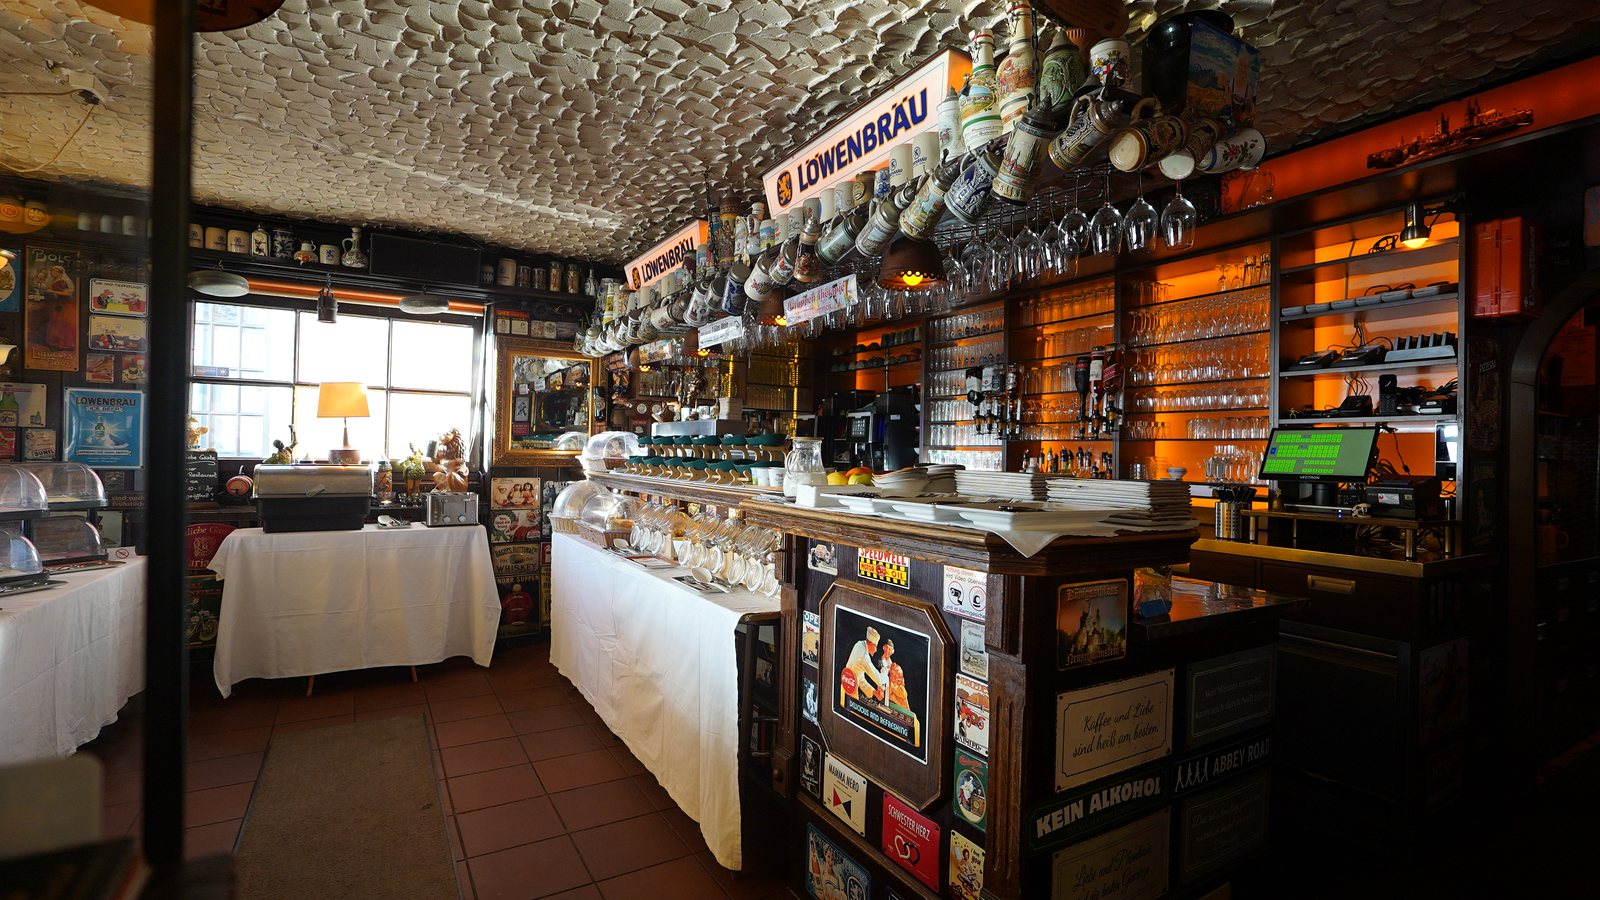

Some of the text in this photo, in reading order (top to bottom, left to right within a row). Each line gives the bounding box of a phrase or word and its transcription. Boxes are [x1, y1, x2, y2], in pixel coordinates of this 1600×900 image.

[797, 87, 928, 193] LÖWENBRÄU
[641, 236, 695, 283] LÖWENBRÄU
[496, 563, 537, 573] WHISKEY
[861, 563, 904, 579] MOTOR OIL
[804, 612, 820, 625] OPE
[849, 700, 909, 737] DELICIOUS AND REFRESHING
[1084, 700, 1155, 733] Kaffee und Liebe
[1072, 736, 1096, 758] sind
[1096, 730, 1117, 751] heiß
[1117, 733, 1132, 745] am
[1211, 737, 1271, 777] ABBEY ROAD
[829, 763, 846, 784] MAMMA
[846, 775, 859, 792] NERO
[1035, 799, 1085, 839] KEIN
[1088, 776, 1161, 815] ALKOHOL
